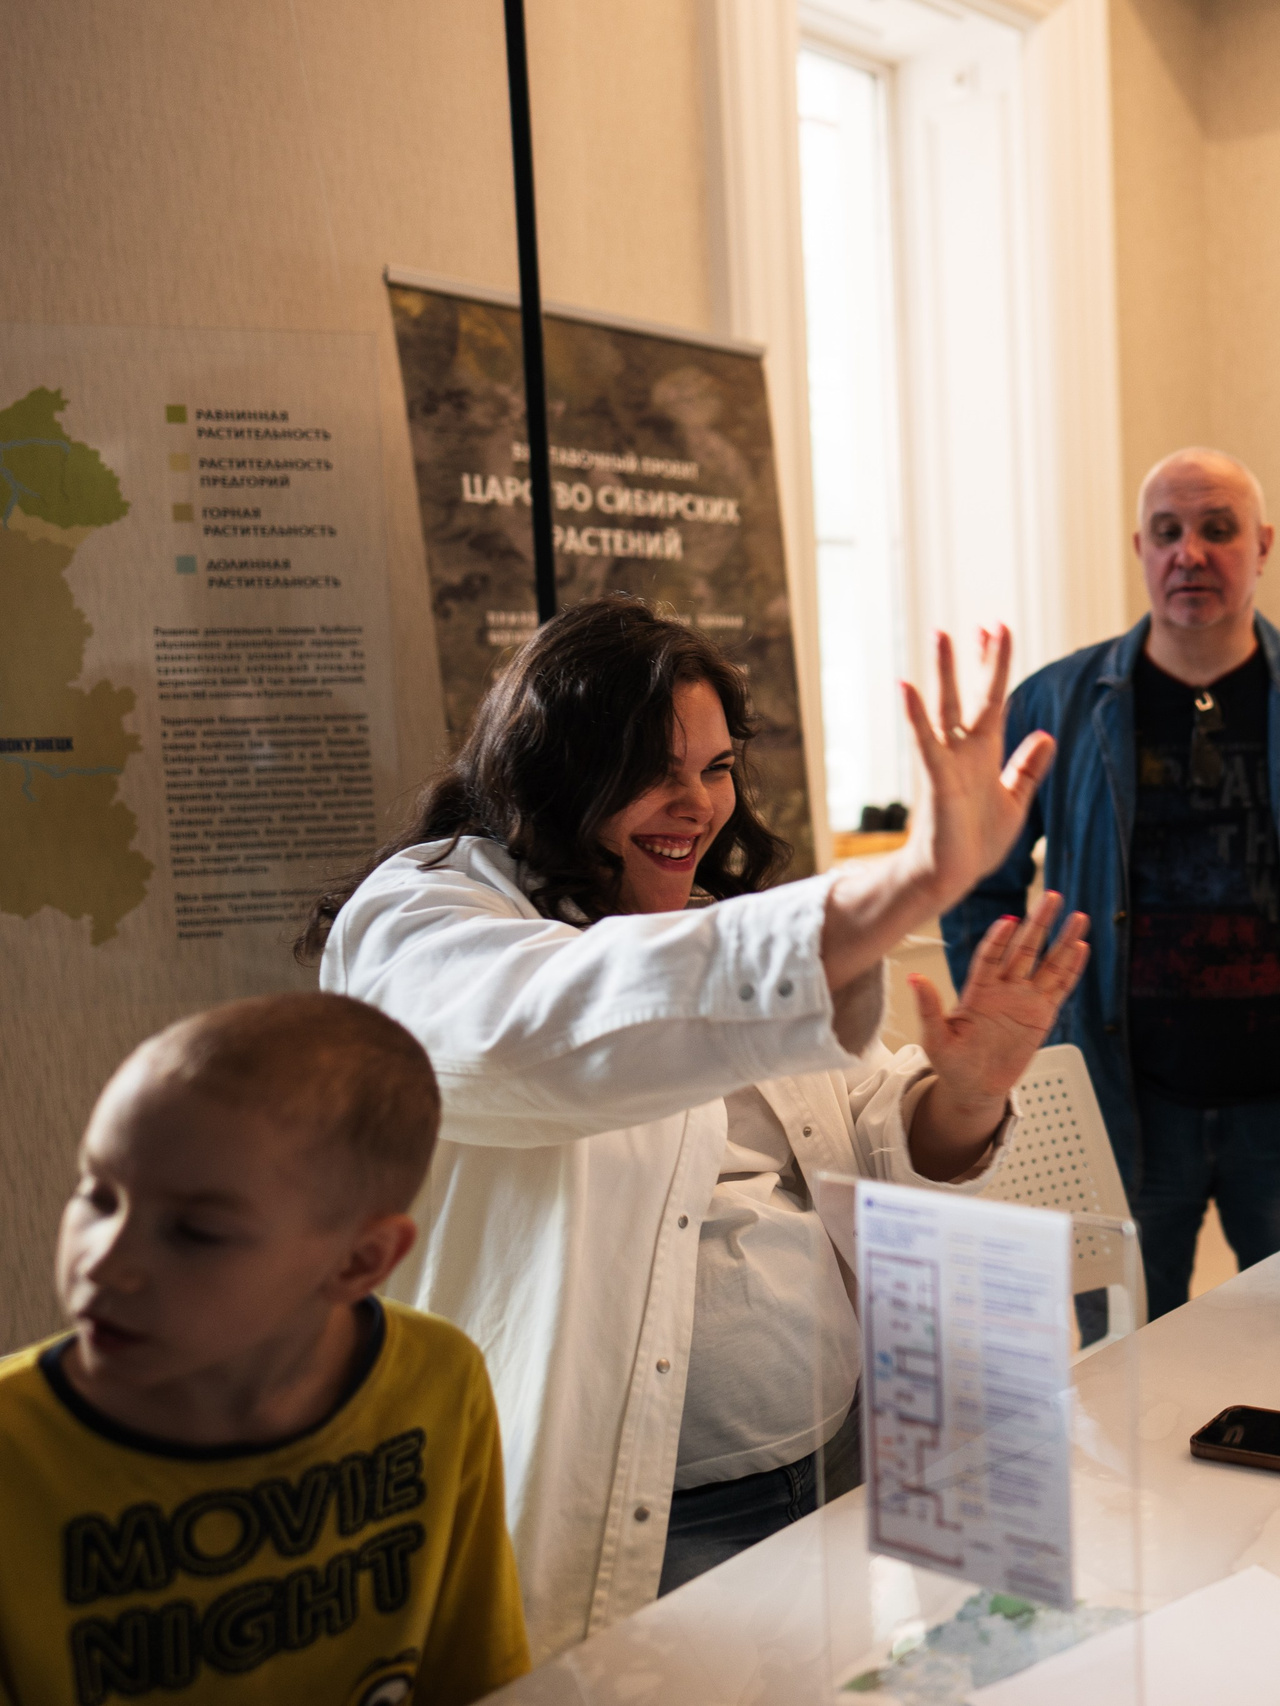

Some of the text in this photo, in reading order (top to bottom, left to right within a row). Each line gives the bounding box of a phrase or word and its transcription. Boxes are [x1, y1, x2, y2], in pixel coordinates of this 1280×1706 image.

[196, 408, 289, 422] РАВНИННАЯ
[196, 426, 332, 441] РАСТИТЕЛЬНОСТЬ
[198, 457, 333, 471] РАСТИТЕЛЬНОСТЬ
[200, 473, 290, 488] ПРЕДГОРИЙ
[597, 485, 741, 525] СИБИРСКИХ
[202, 506, 262, 520] ГОРНАЯ
[203, 525, 337, 538] РАСТИТЕЛЬНОСТЬ
[207, 558, 291, 572] ДОЛИННАЯ
[208, 575, 342, 589] РАСТИТЕЛЬНОСТЬ
[65, 1427, 426, 1606] MOVIE
[71, 1521, 426, 1705] NIGHT
